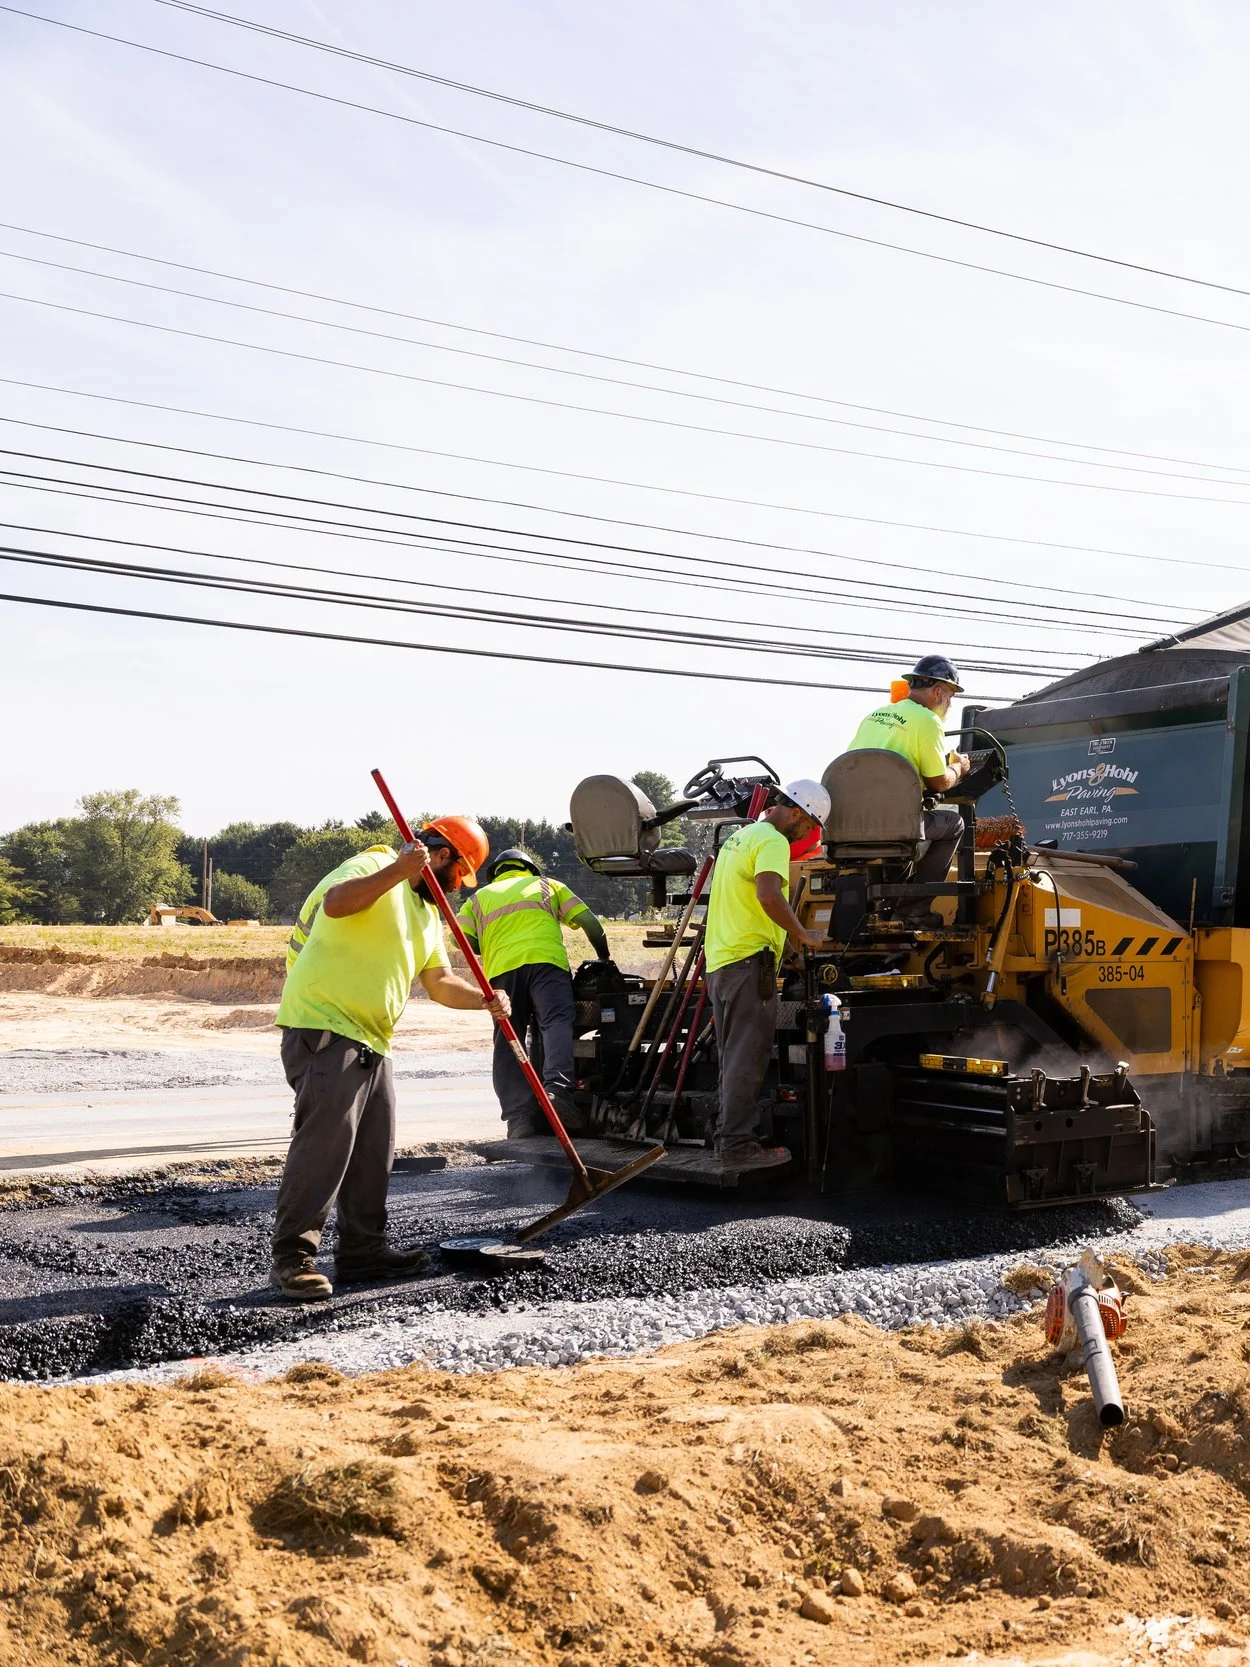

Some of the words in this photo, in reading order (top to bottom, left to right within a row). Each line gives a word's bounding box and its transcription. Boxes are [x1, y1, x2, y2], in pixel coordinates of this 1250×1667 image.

[1052, 769, 1095, 791] Lyons
[1104, 764, 1139, 784] Hohl
[1066, 786, 1116, 803] Paving
[1060, 807, 1078, 817] EAST
[1079, 806, 1099, 815] EARL,
[1101, 804, 1113, 813] PA.
[1045, 817, 1128, 829] www.lyonshohlpaving.com
[1062, 829, 1108, 841] 717-355-9219
[1098, 965, 1145, 983] 385-04
